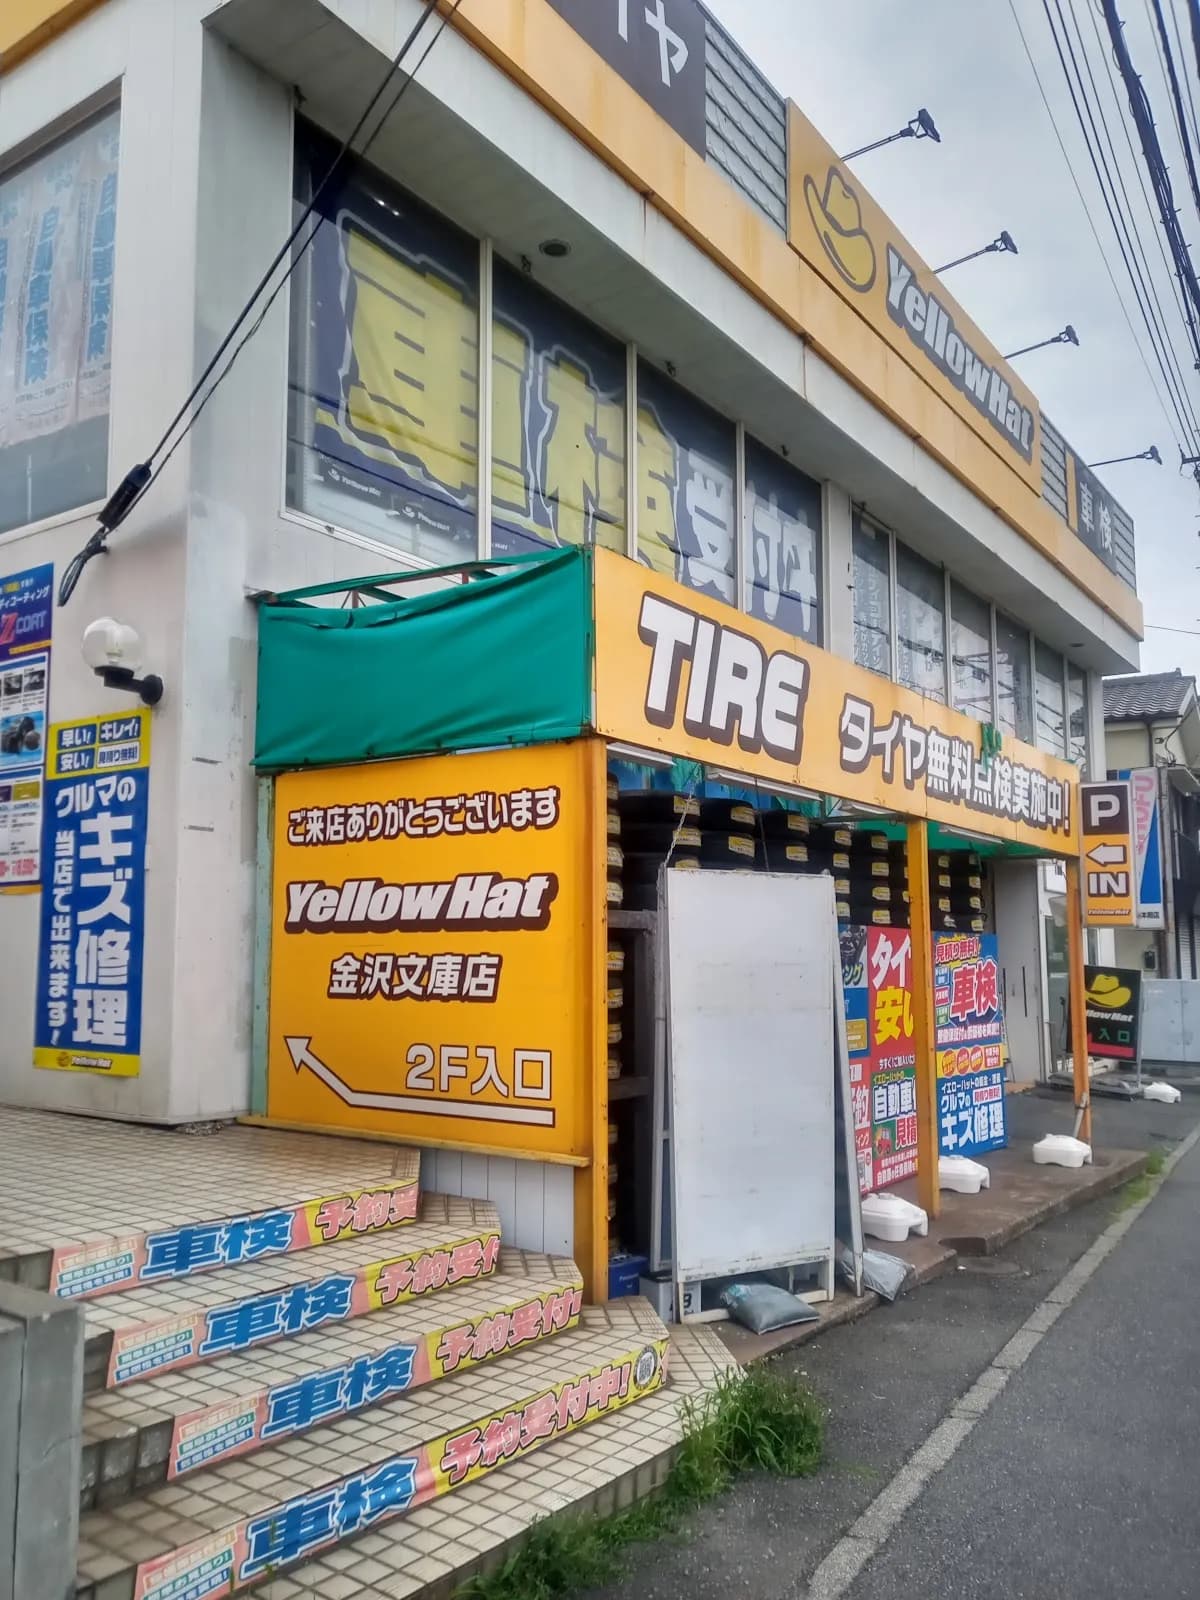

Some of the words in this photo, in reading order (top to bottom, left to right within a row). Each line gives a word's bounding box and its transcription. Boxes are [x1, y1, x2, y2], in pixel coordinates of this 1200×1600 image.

[24, 206, 60, 386] 自動車保険
[887, 245, 1034, 459] YellowHat
[1080, 481, 1113, 555] 車検
[639, 593, 809, 763] TIRE
[55, 776, 137, 818] クルマの
[287, 786, 560, 846] ご来店ありがとうございます
[1091, 794, 1121, 826] P
[285, 873, 558, 932] YellowHat
[1088, 871, 1129, 897] IN
[72, 811, 133, 1047] キズ修理
[872, 933, 911, 990] タイ
[328, 953, 502, 1002] 金沢文庫店
[950, 957, 998, 1021] 車検
[405, 1043, 551, 1100] 2F入口
[874, 1077, 916, 1122] 自動車
[941, 1101, 1004, 1151] キズ修理
[140, 1210, 297, 1279] 車検
[198, 1273, 357, 1356] 車検
[436, 1287, 582, 1374] 予約受付
[261, 1342, 420, 1440] 車検
[441, 1362, 631, 1485] 予約受付中!
[239, 1455, 419, 1582] 車検
